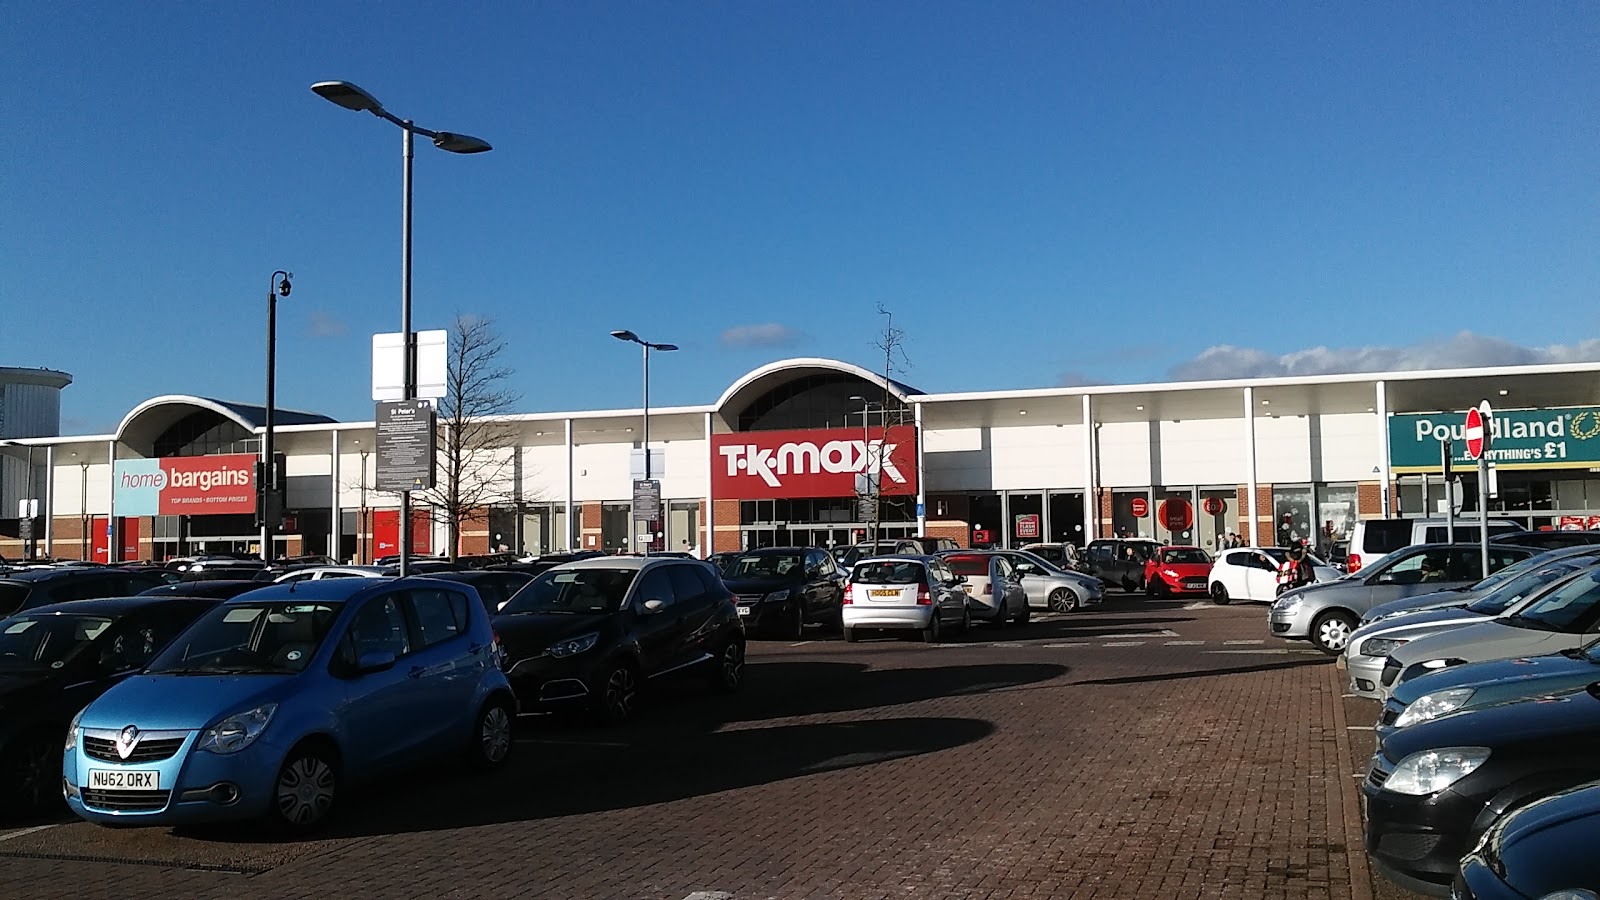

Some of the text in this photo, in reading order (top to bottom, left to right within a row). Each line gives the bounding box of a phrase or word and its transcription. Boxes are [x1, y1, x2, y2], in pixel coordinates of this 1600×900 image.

[1416, 415, 1565, 442] Poudland
[1454, 441, 1567, 462] ...ERYTHING'S £1
[121, 465, 249, 491] home bargains
[93, 772, 152, 787] NU62 ORX
